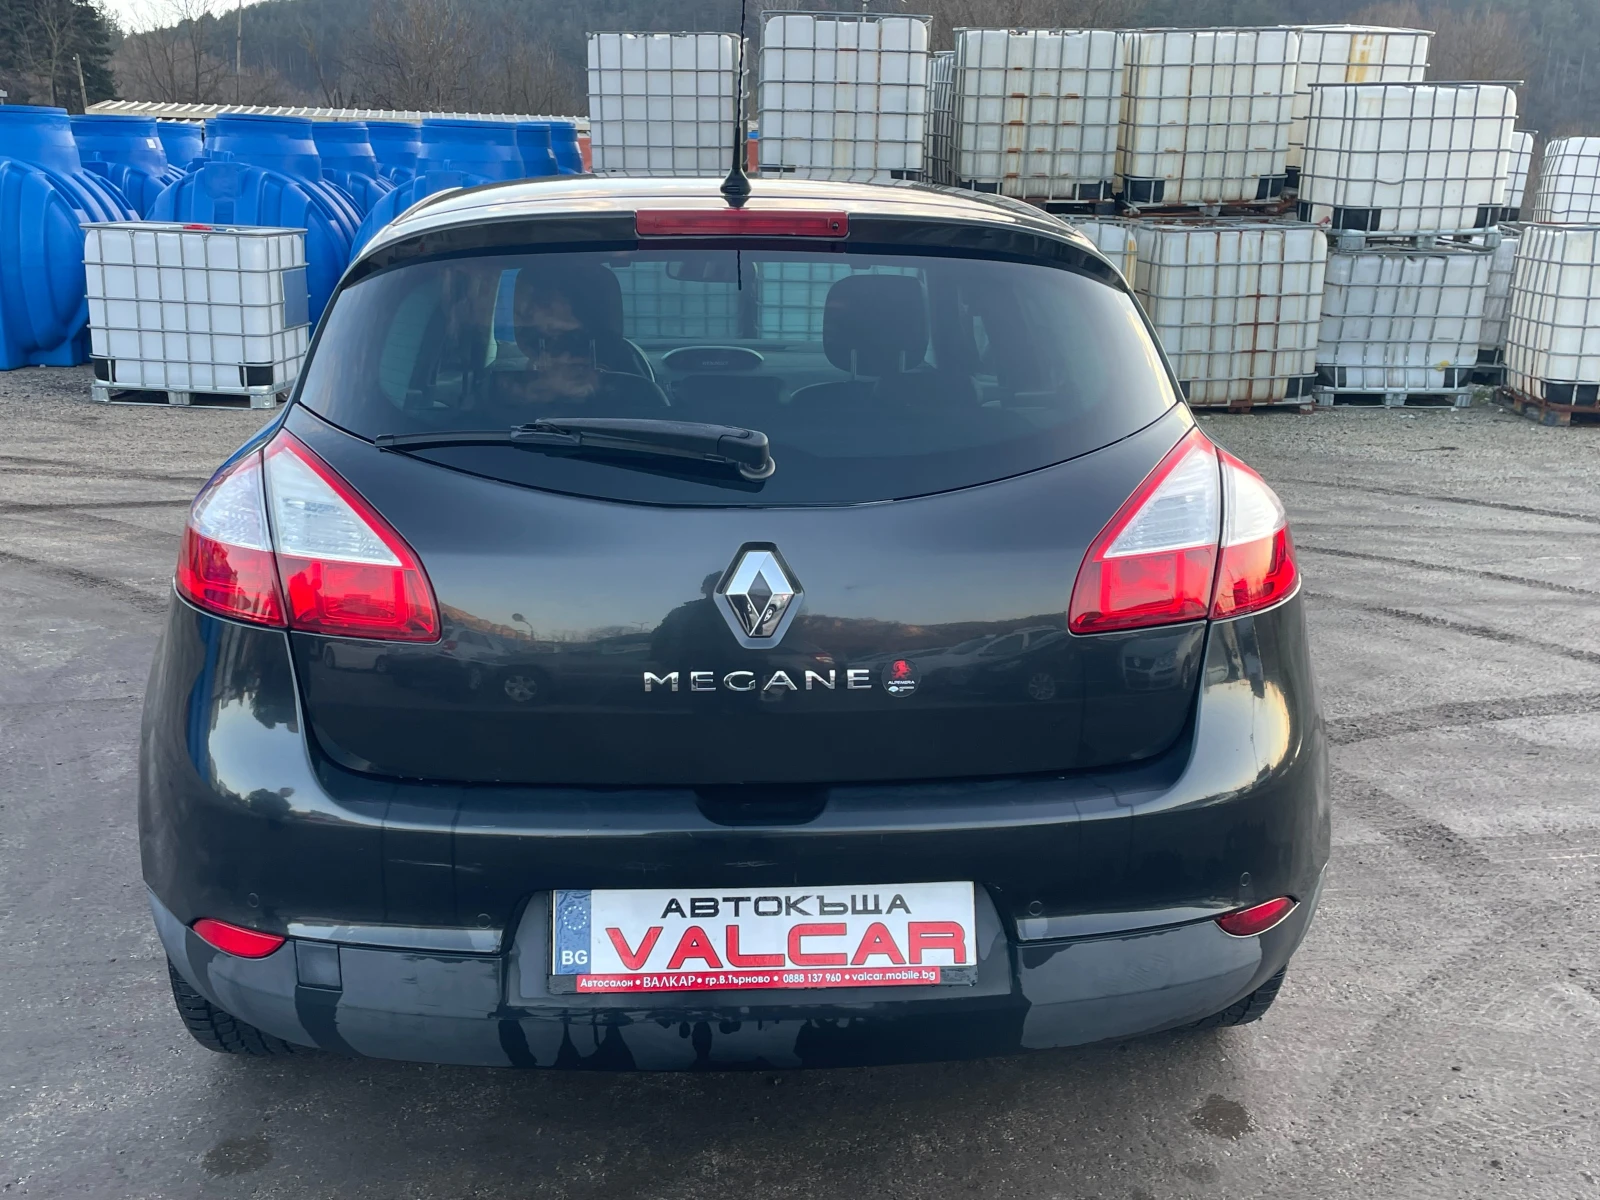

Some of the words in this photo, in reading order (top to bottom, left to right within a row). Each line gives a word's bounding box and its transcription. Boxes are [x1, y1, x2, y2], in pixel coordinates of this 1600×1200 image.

[643, 669, 872, 691] MEGANE
[660, 893, 912, 919] АВТОКЪЩА
[605, 921, 967, 970] VALCAR
[562, 950, 588, 965] BG
[580, 978, 633, 988] Автосалон
[643, 975, 696, 987] ВАЛКАР
[783, 973, 805, 983] 0888
[807, 973, 823, 983] 137
[825, 972, 842, 983] 960
[852, 969, 936, 981] valcar.mobile.bg
